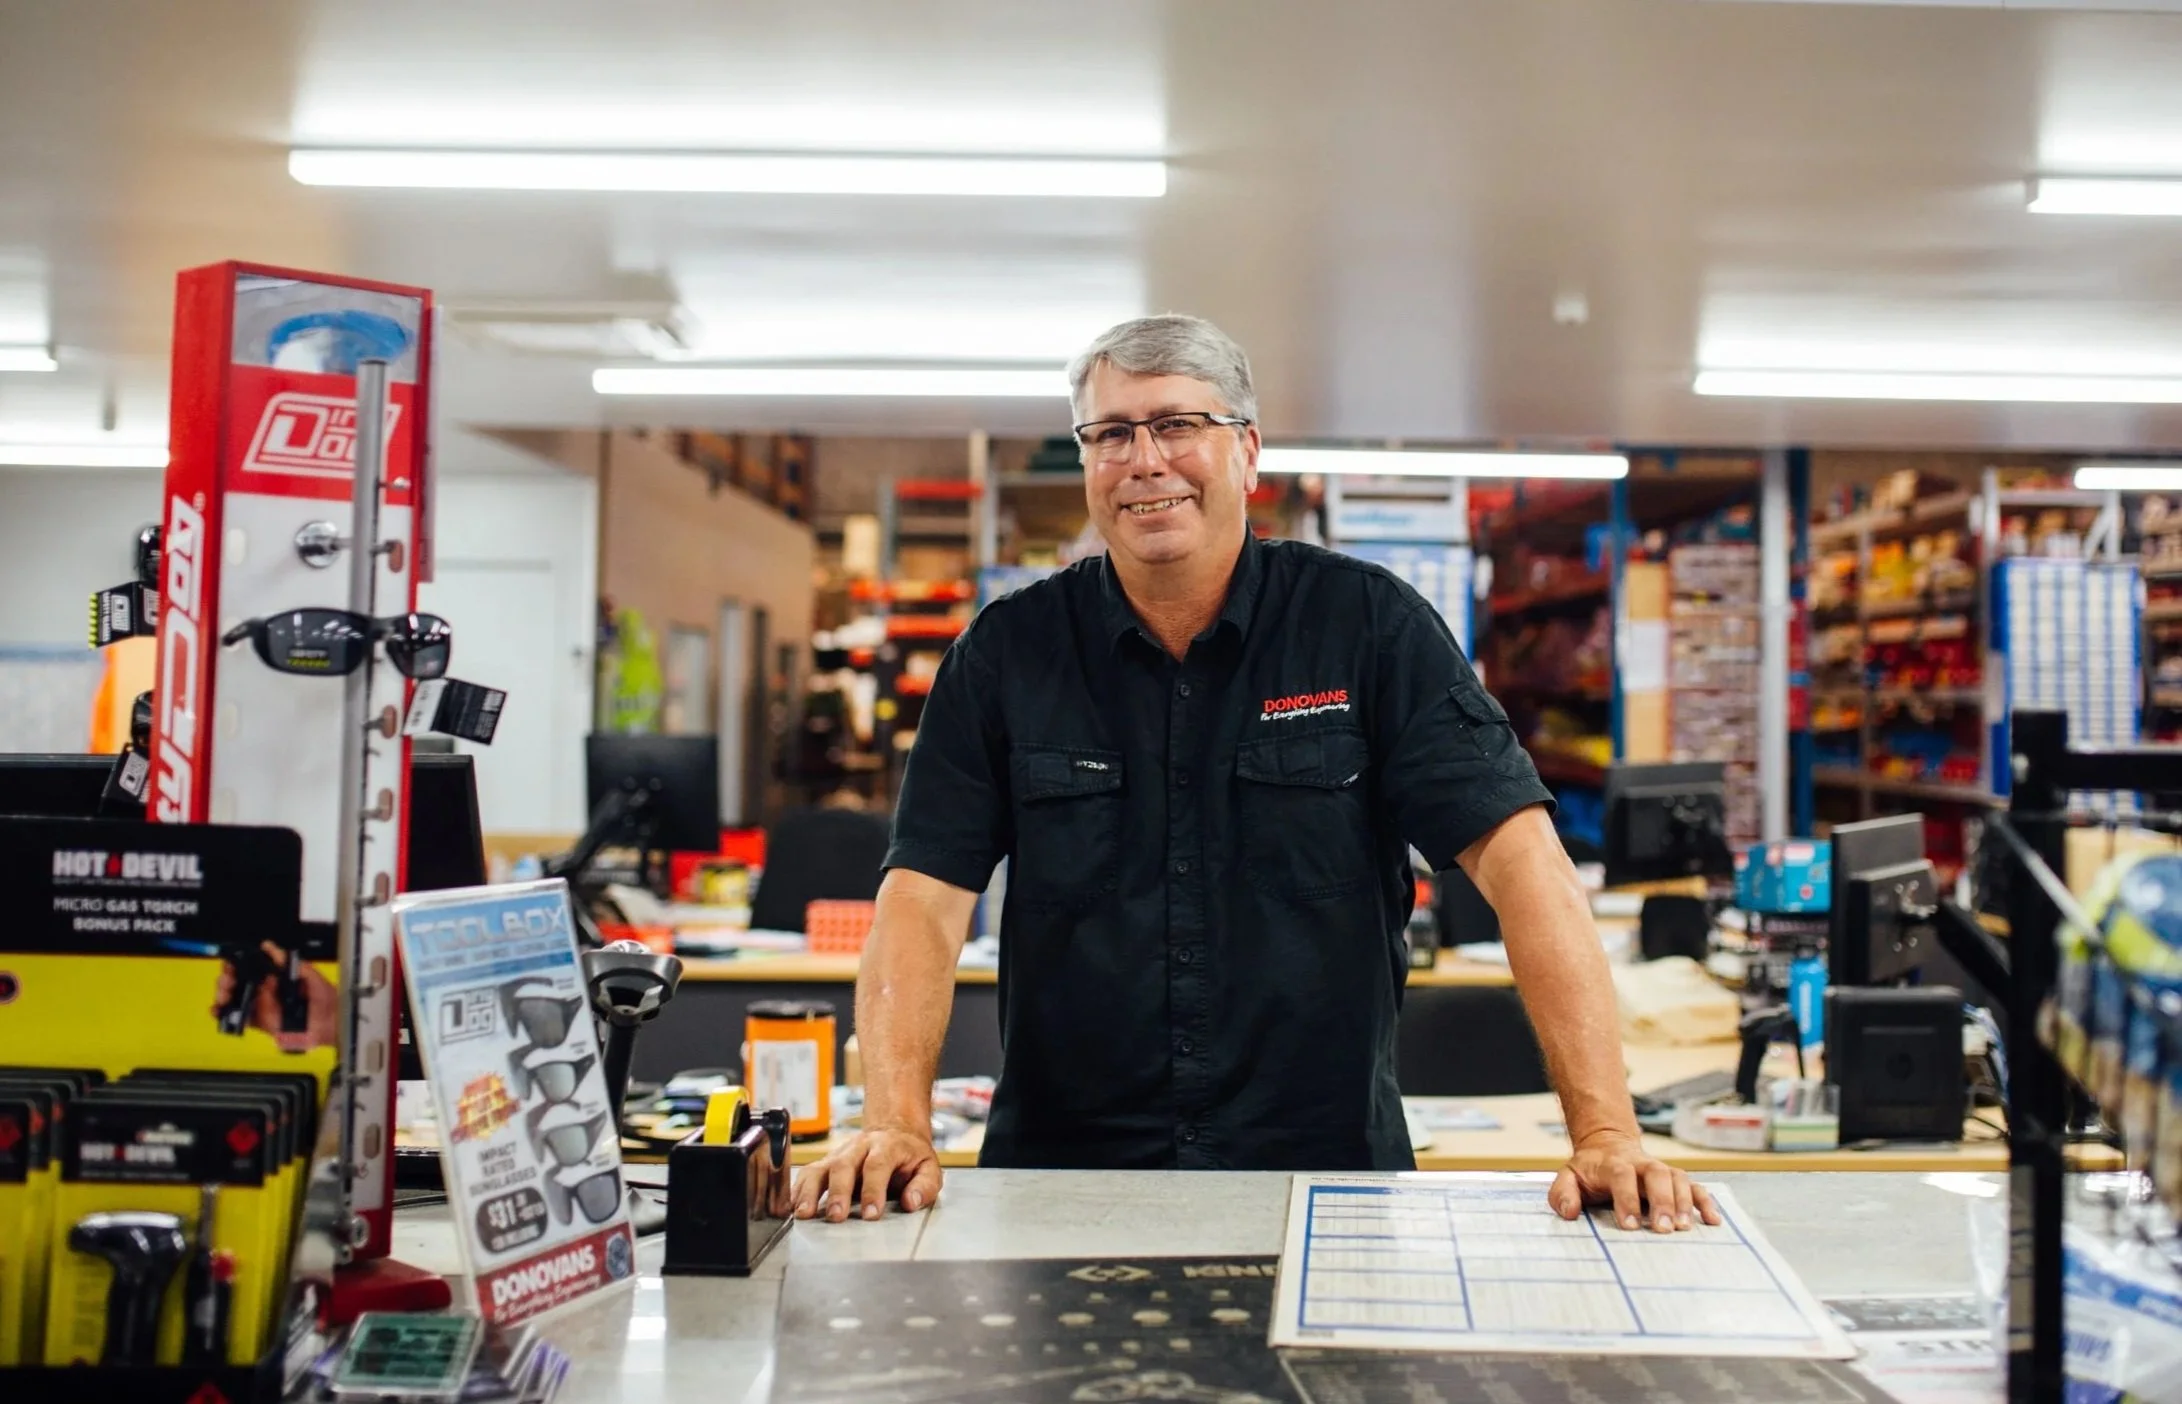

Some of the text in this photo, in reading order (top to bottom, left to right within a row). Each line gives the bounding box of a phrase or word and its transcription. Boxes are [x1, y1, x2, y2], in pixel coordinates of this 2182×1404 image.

[1264, 690, 1349, 713] DONOVANS
[52, 850, 204, 880] HOT DEVIL
[53, 897, 199, 915] MICRO GAS TORCH
[73, 917, 177, 933] BONUS PACK
[411, 907, 566, 955] TOOLBOX
[478, 1141, 517, 1162] IMPACT
[482, 1158, 516, 1177] RATED
[491, 1244, 596, 1306] DONOVANS
